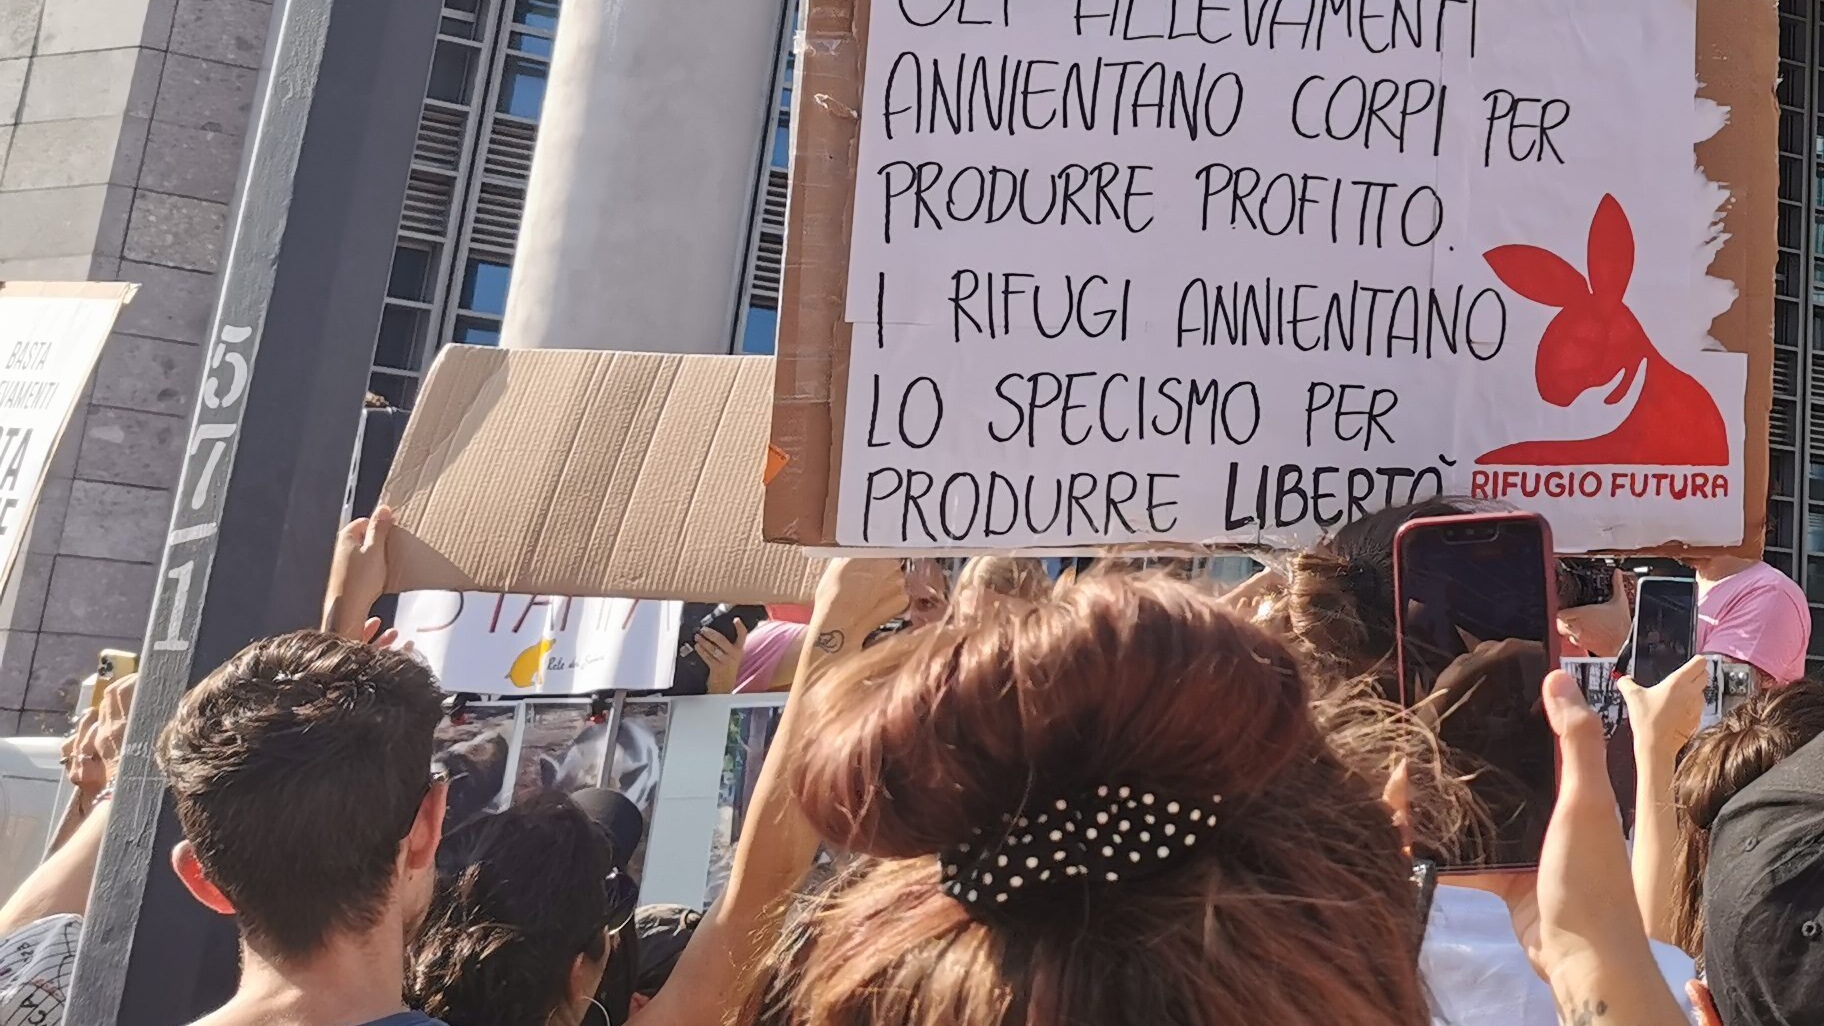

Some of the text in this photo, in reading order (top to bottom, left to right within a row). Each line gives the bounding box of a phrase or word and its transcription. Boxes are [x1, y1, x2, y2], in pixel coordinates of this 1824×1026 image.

[882, 51, 1571, 167] ANNIENTANO CORPI PER
[877, 161, 1455, 251] PRODURRE PROFITTO.
[878, 269, 1506, 361] I RIFUGI ANNIENTANO
[5, 341, 52, 370] BASTA
[866, 372, 1398, 450] LO SPECISMO PER
[863, 467, 1181, 542] PRODURRE
[1471, 469, 1729, 500] RIFUGIO FUTURA
